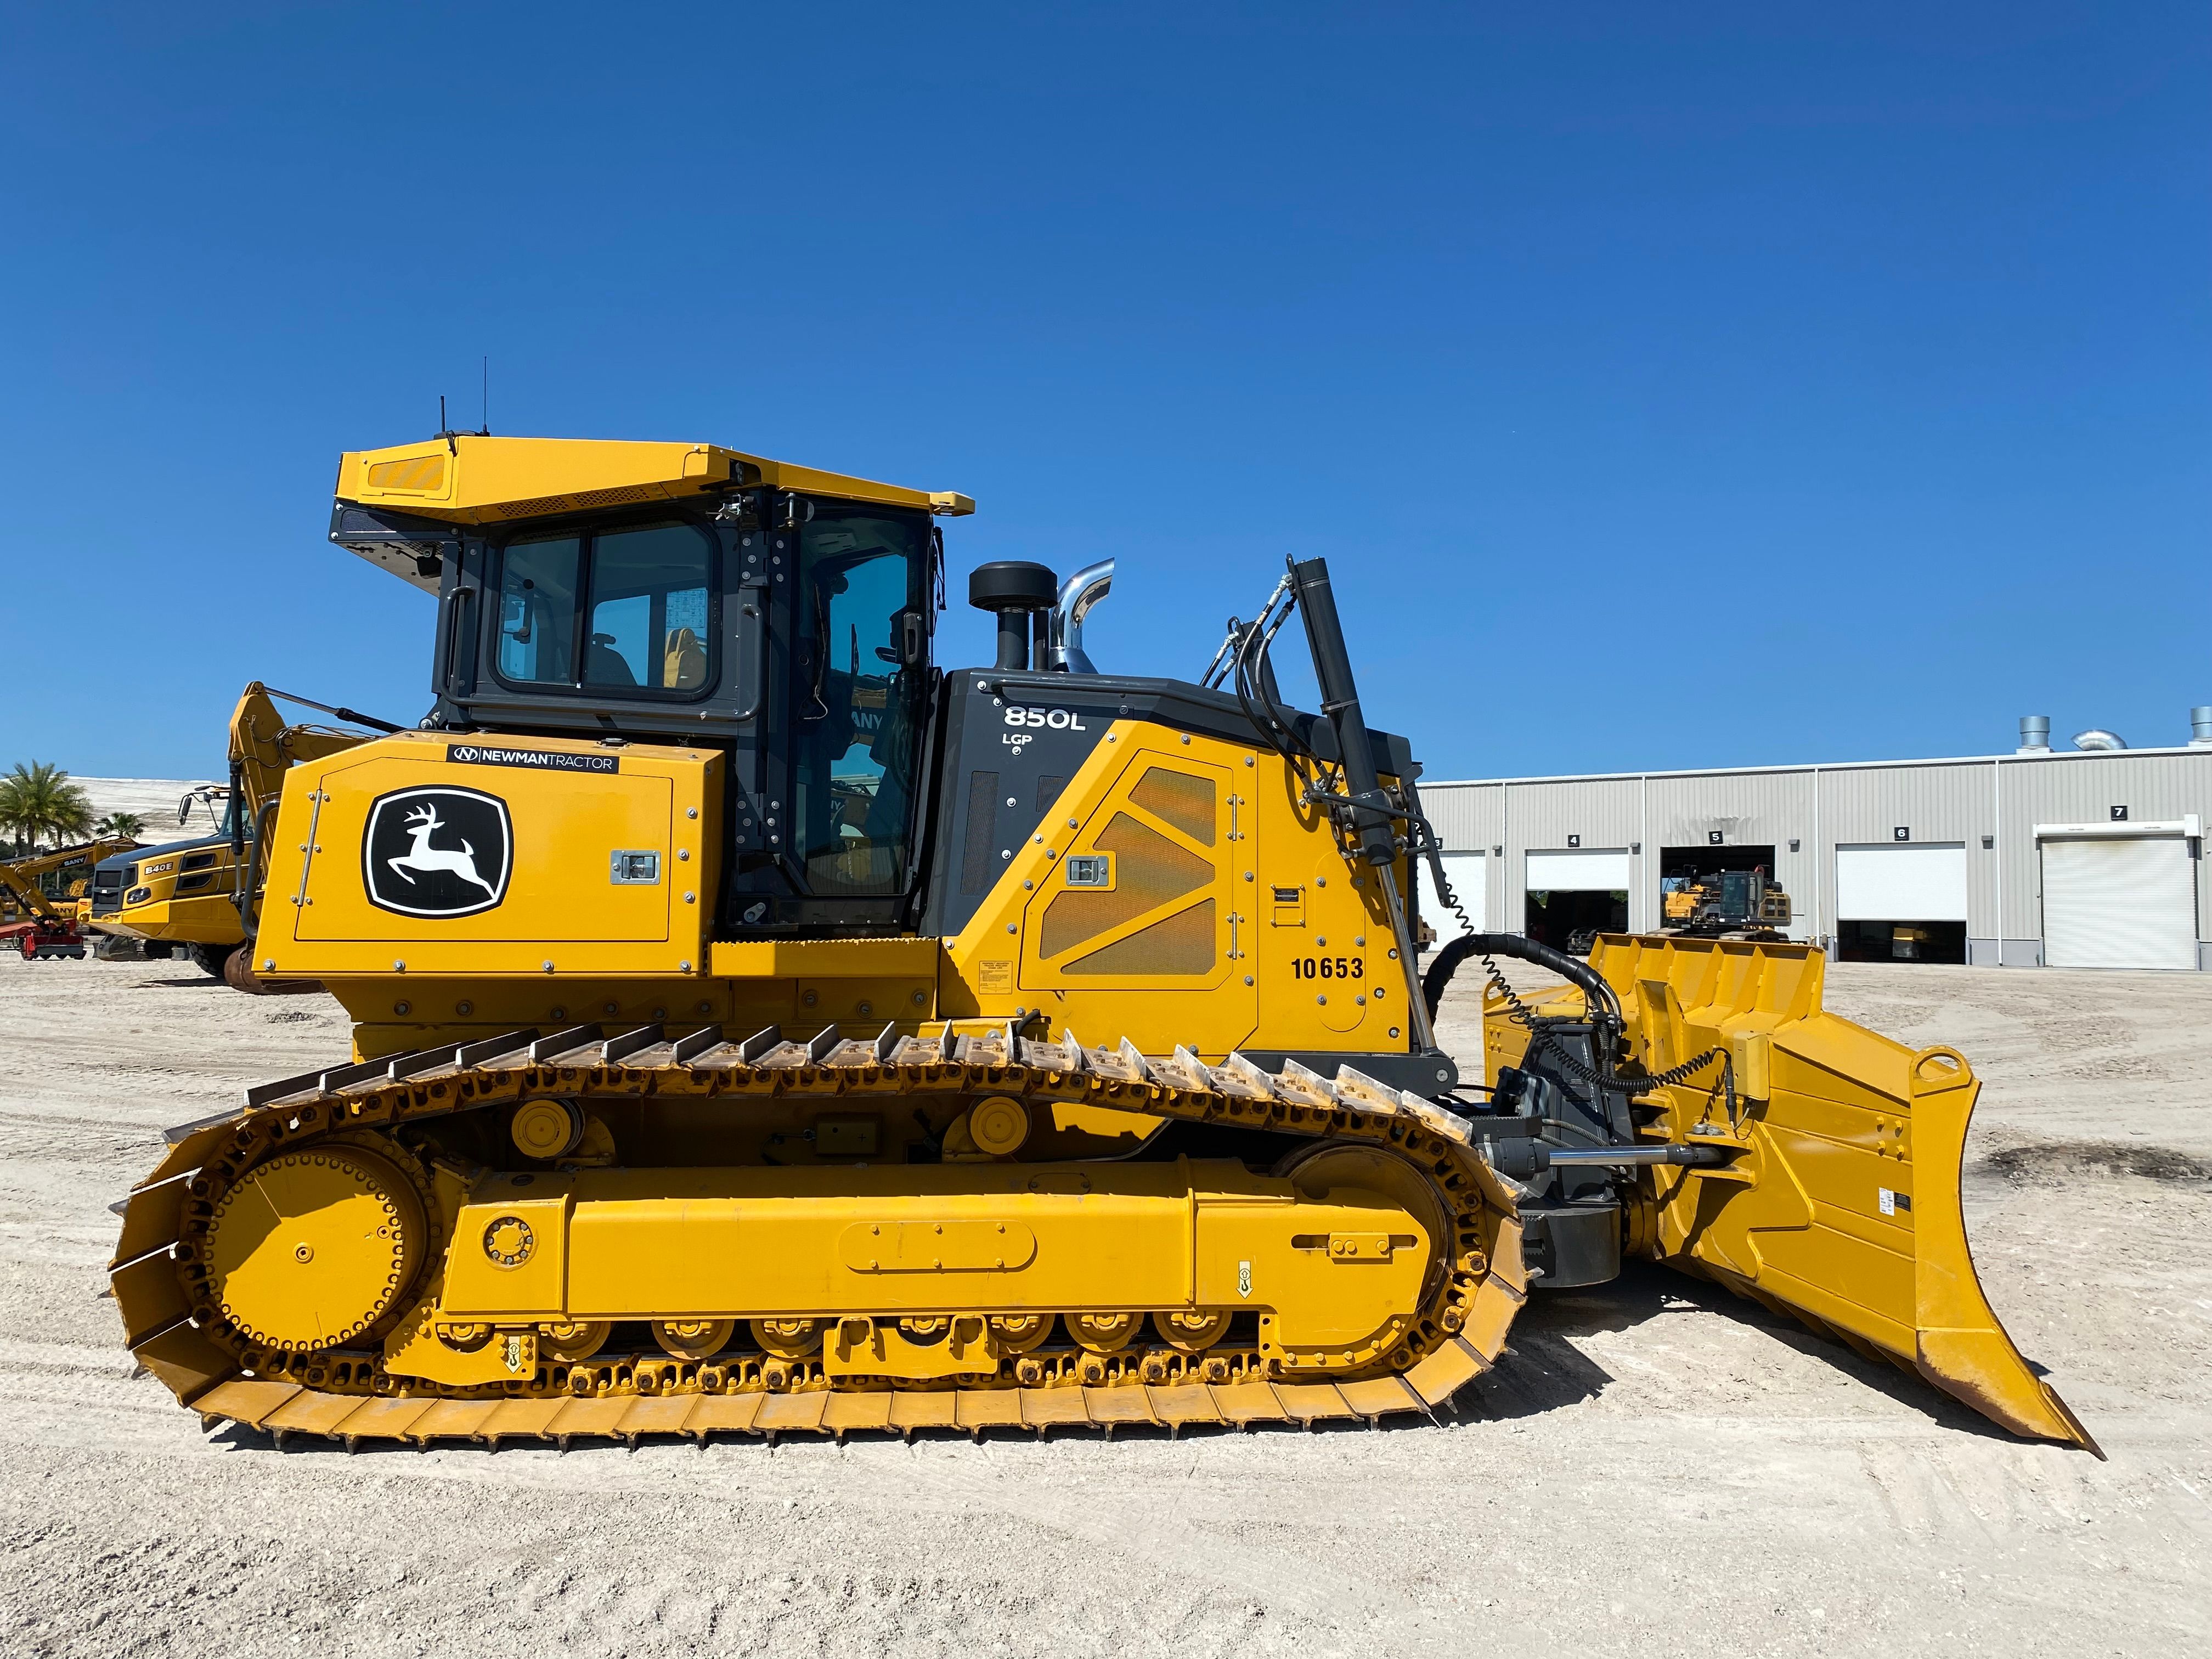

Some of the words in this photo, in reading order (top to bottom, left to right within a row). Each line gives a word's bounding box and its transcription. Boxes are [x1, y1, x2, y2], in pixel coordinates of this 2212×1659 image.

[851, 711, 883, 729] ANY
[1005, 706, 1086, 731] 850L
[1002, 733, 1032, 745] LGP
[2115, 808, 2123, 816] 7
[1898, 829, 1905, 837] 6
[64, 857, 84, 866] SANY
[145, 862, 173, 875] B40E
[1291, 957, 1364, 979] 10653
